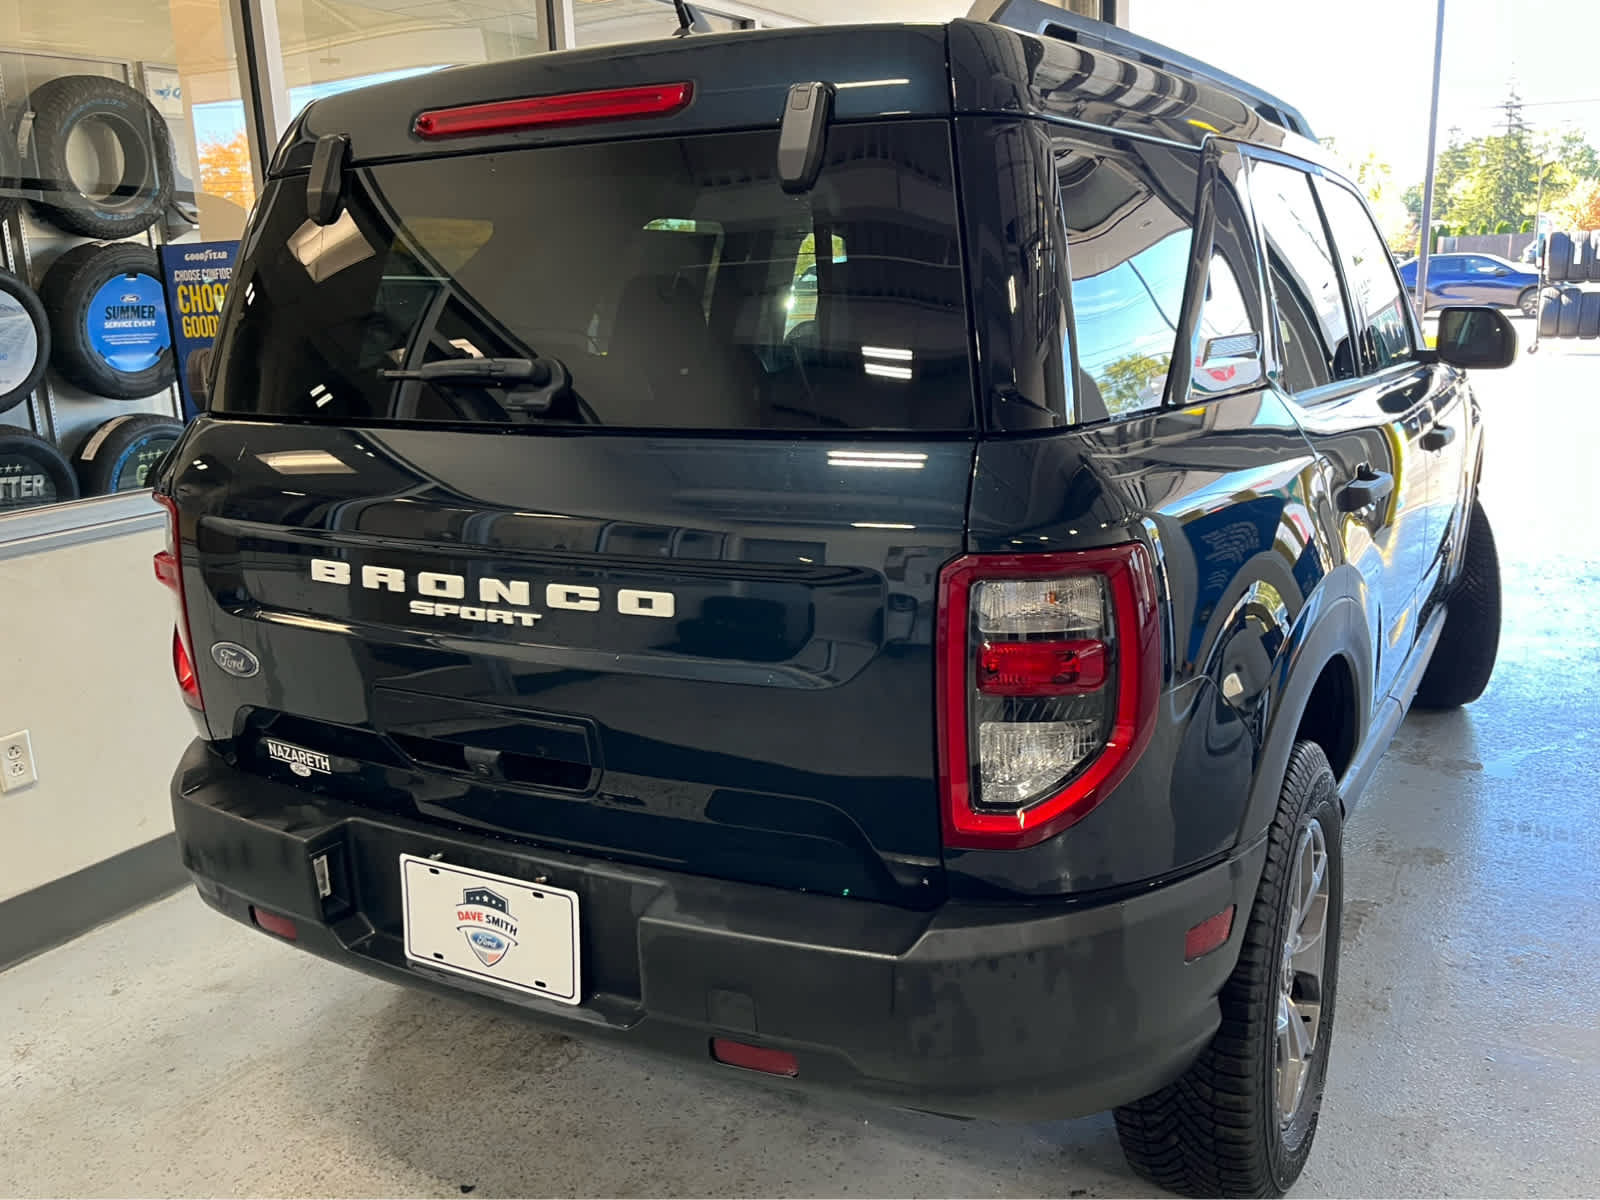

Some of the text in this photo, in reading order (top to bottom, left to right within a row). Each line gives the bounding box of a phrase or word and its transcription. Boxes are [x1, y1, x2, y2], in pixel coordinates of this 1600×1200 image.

[184, 249, 228, 261] GOODYEAR
[174, 269, 201, 281] CHOOSE
[104, 304, 156, 320] SUMMER
[104, 319, 156, 329] SERVICE EVENT
[311, 558, 675, 618] BRONCO
[409, 600, 543, 627] SPORT
[267, 742, 331, 772] NAZARETH
[457, 911, 518, 937] DAVE SMITH
[475, 933, 499, 949] Ford
